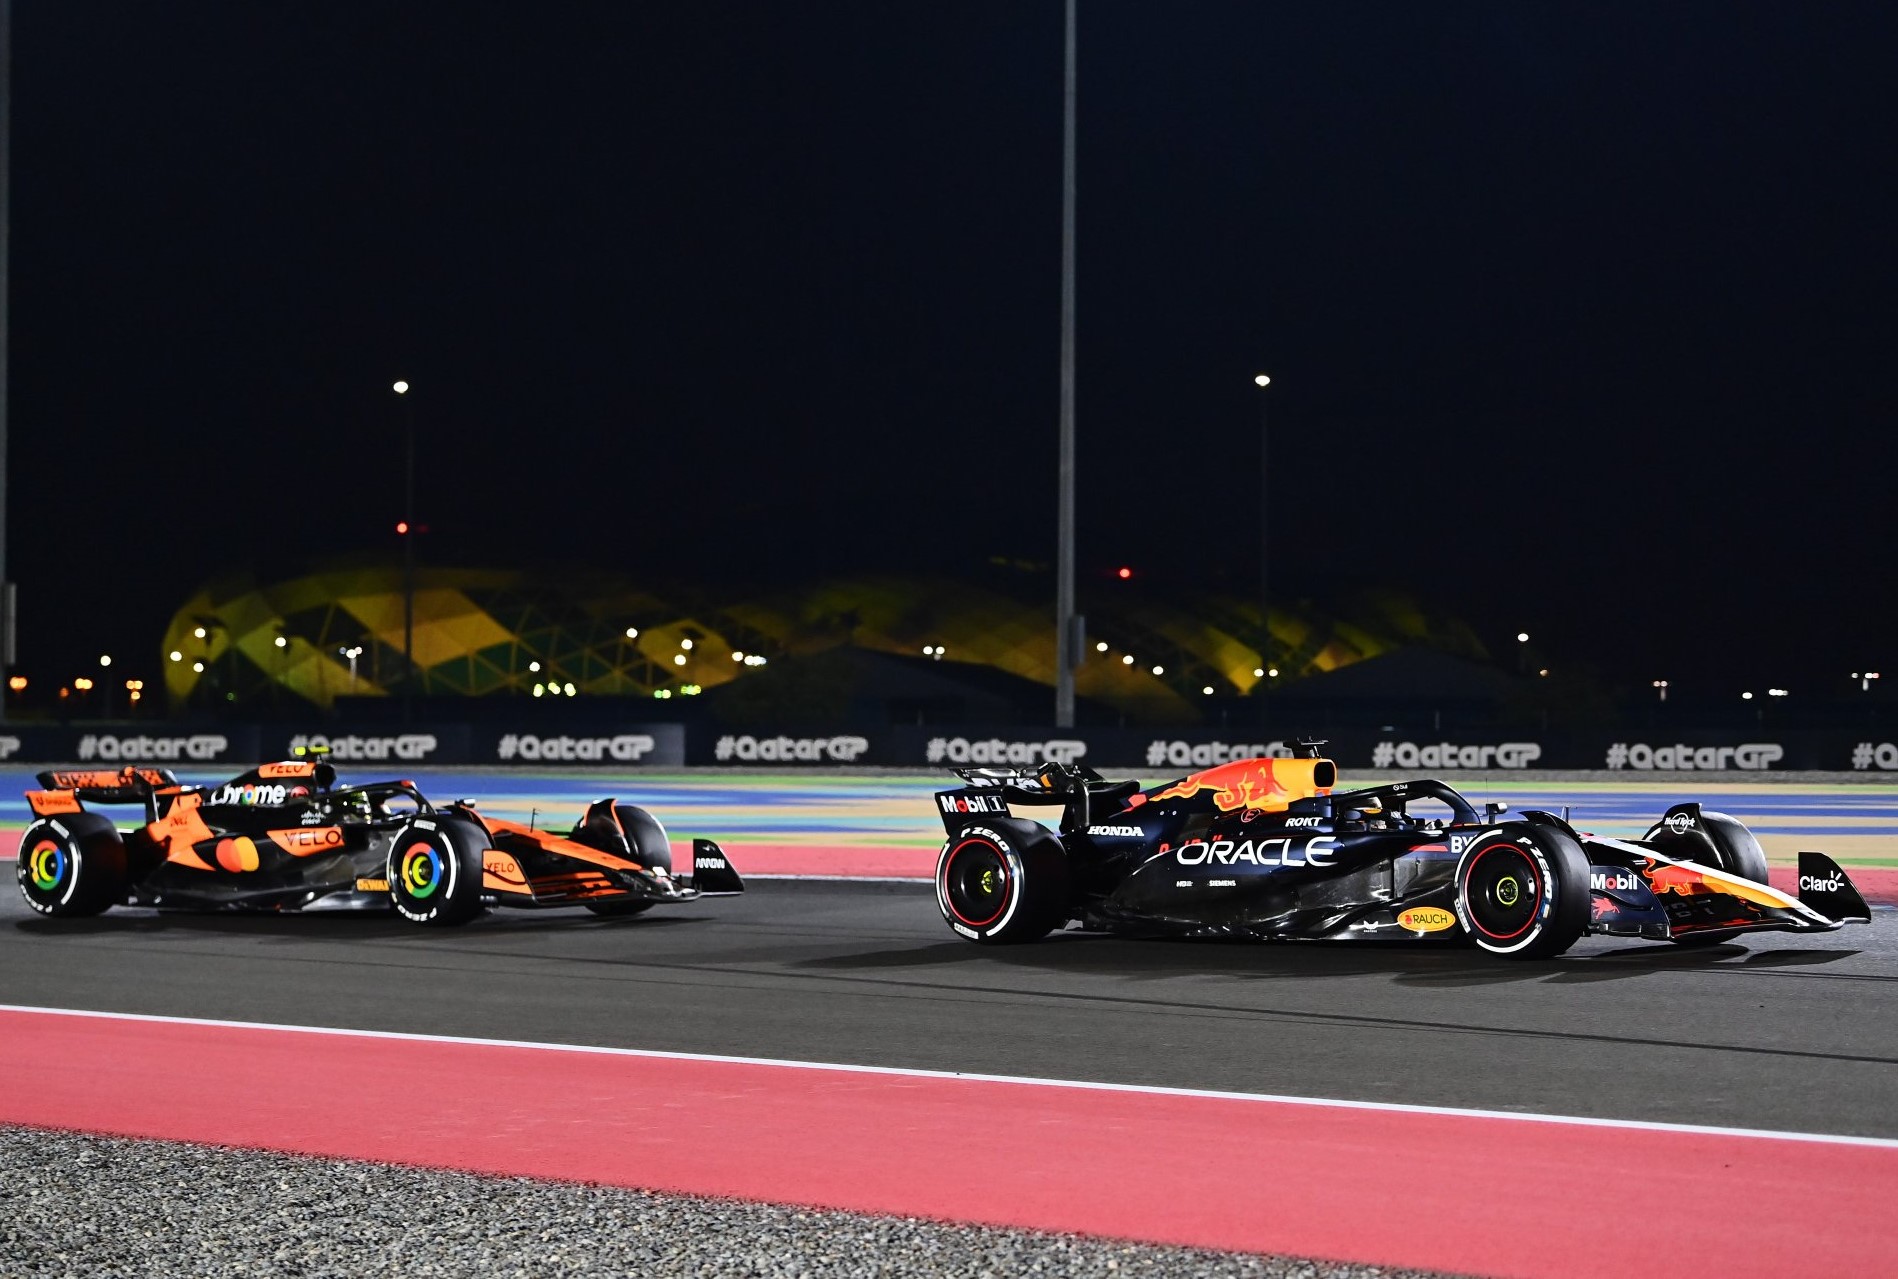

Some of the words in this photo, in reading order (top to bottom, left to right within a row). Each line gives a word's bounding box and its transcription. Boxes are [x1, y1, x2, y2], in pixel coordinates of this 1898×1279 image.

[78, 735, 228, 760] #QatarGP
[498, 735, 655, 760] #QatarGP
[715, 735, 869, 761] #QatarGP
[926, 737, 1087, 765] #QatarGP
[1146, 740, 1296, 767] #QatarG
[1372, 741, 1542, 769] #QatarGP
[1606, 743, 1784, 770] #QatarGP
[940, 795, 989, 813] Mobil
[1087, 825, 1145, 837] HONDA
[1285, 817, 1323, 828] ROKT
[284, 830, 342, 847] VELO
[1176, 836, 1339, 867] ORACLE
[1590, 873, 1638, 891] Mobil
[1799, 875, 1838, 893] Claro
[1413, 914, 1448, 925] RAUCH
